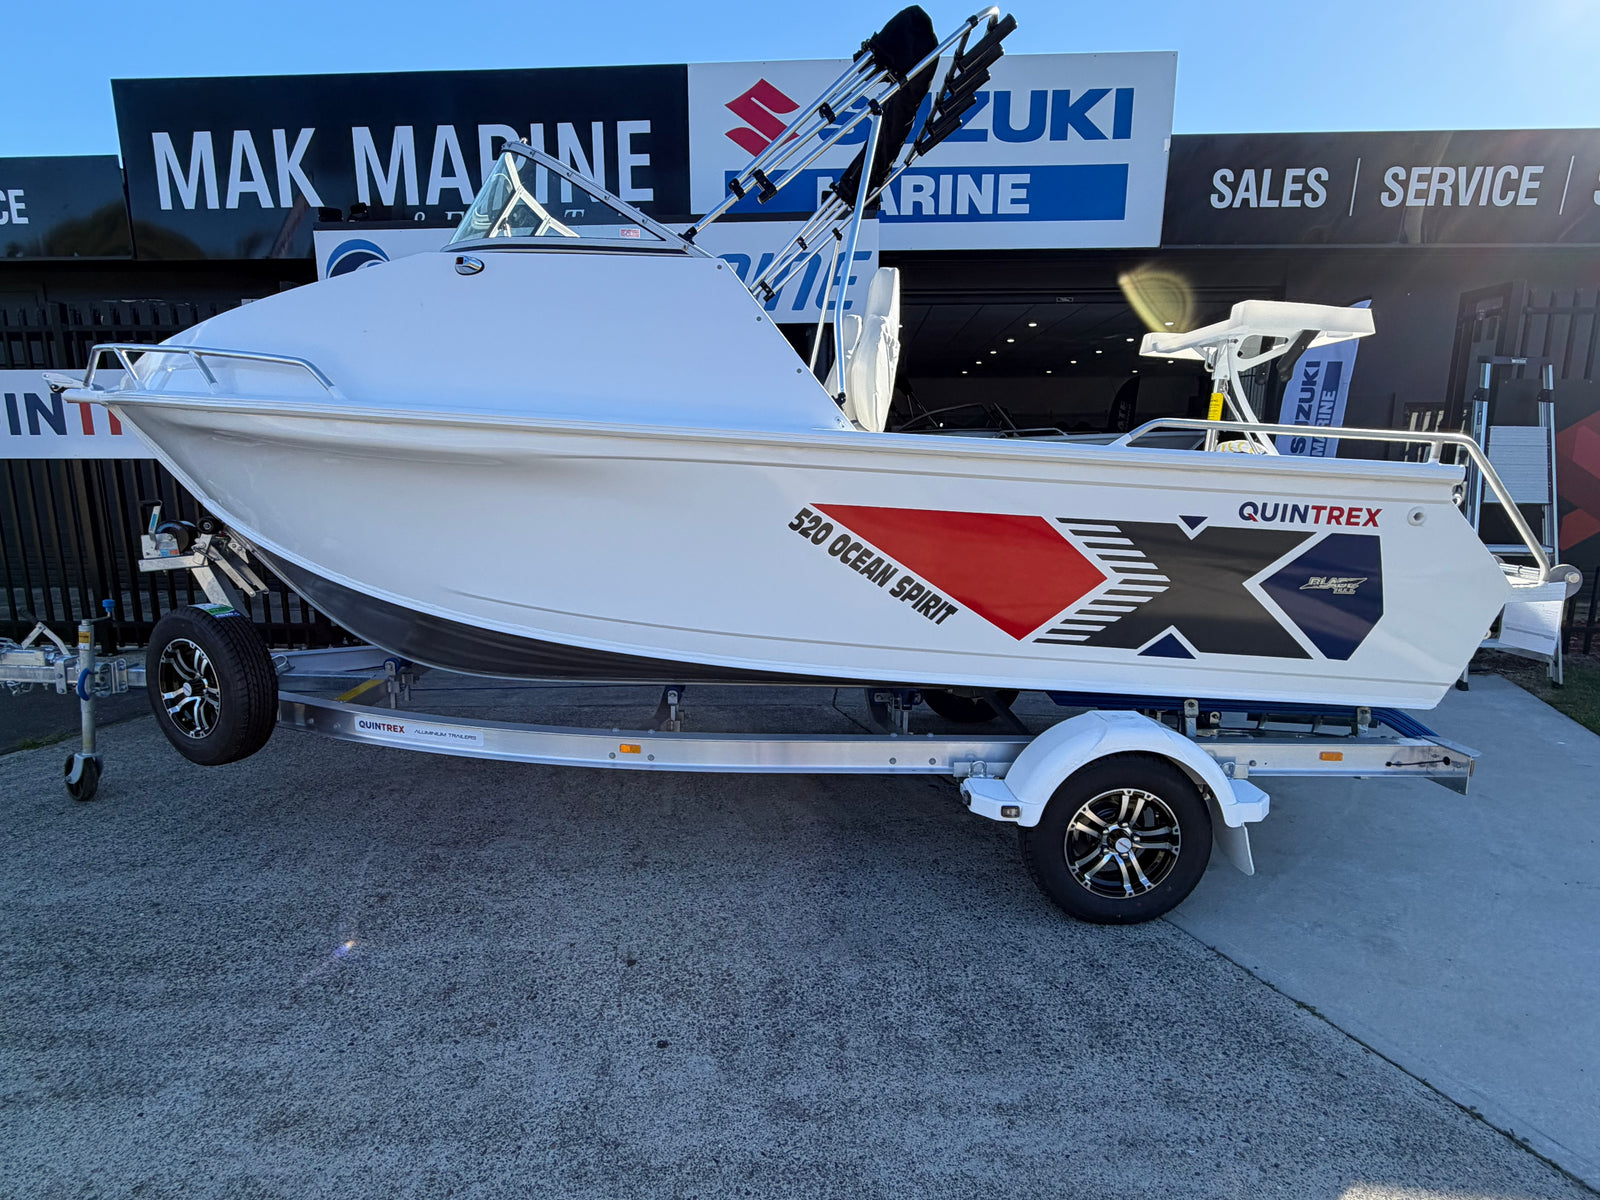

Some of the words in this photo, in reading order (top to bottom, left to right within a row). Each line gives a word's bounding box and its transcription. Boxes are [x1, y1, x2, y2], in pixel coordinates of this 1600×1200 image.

[152, 127, 325, 210] MAK
[351, 119, 654, 207] MARINE
[1210, 166, 1329, 210] SALES
[1380, 164, 1544, 209] SERVICE
[1238, 501, 1383, 528] QUINTREX
[788, 507, 834, 545] 520
[827, 533, 899, 588] OCEAN
[888, 575, 959, 625] SPIRIT
[358, 720, 405, 734] QUINTREX
[414, 729, 447, 737] ALUMINIUM
[448, 732, 477, 741] TRAILERS
